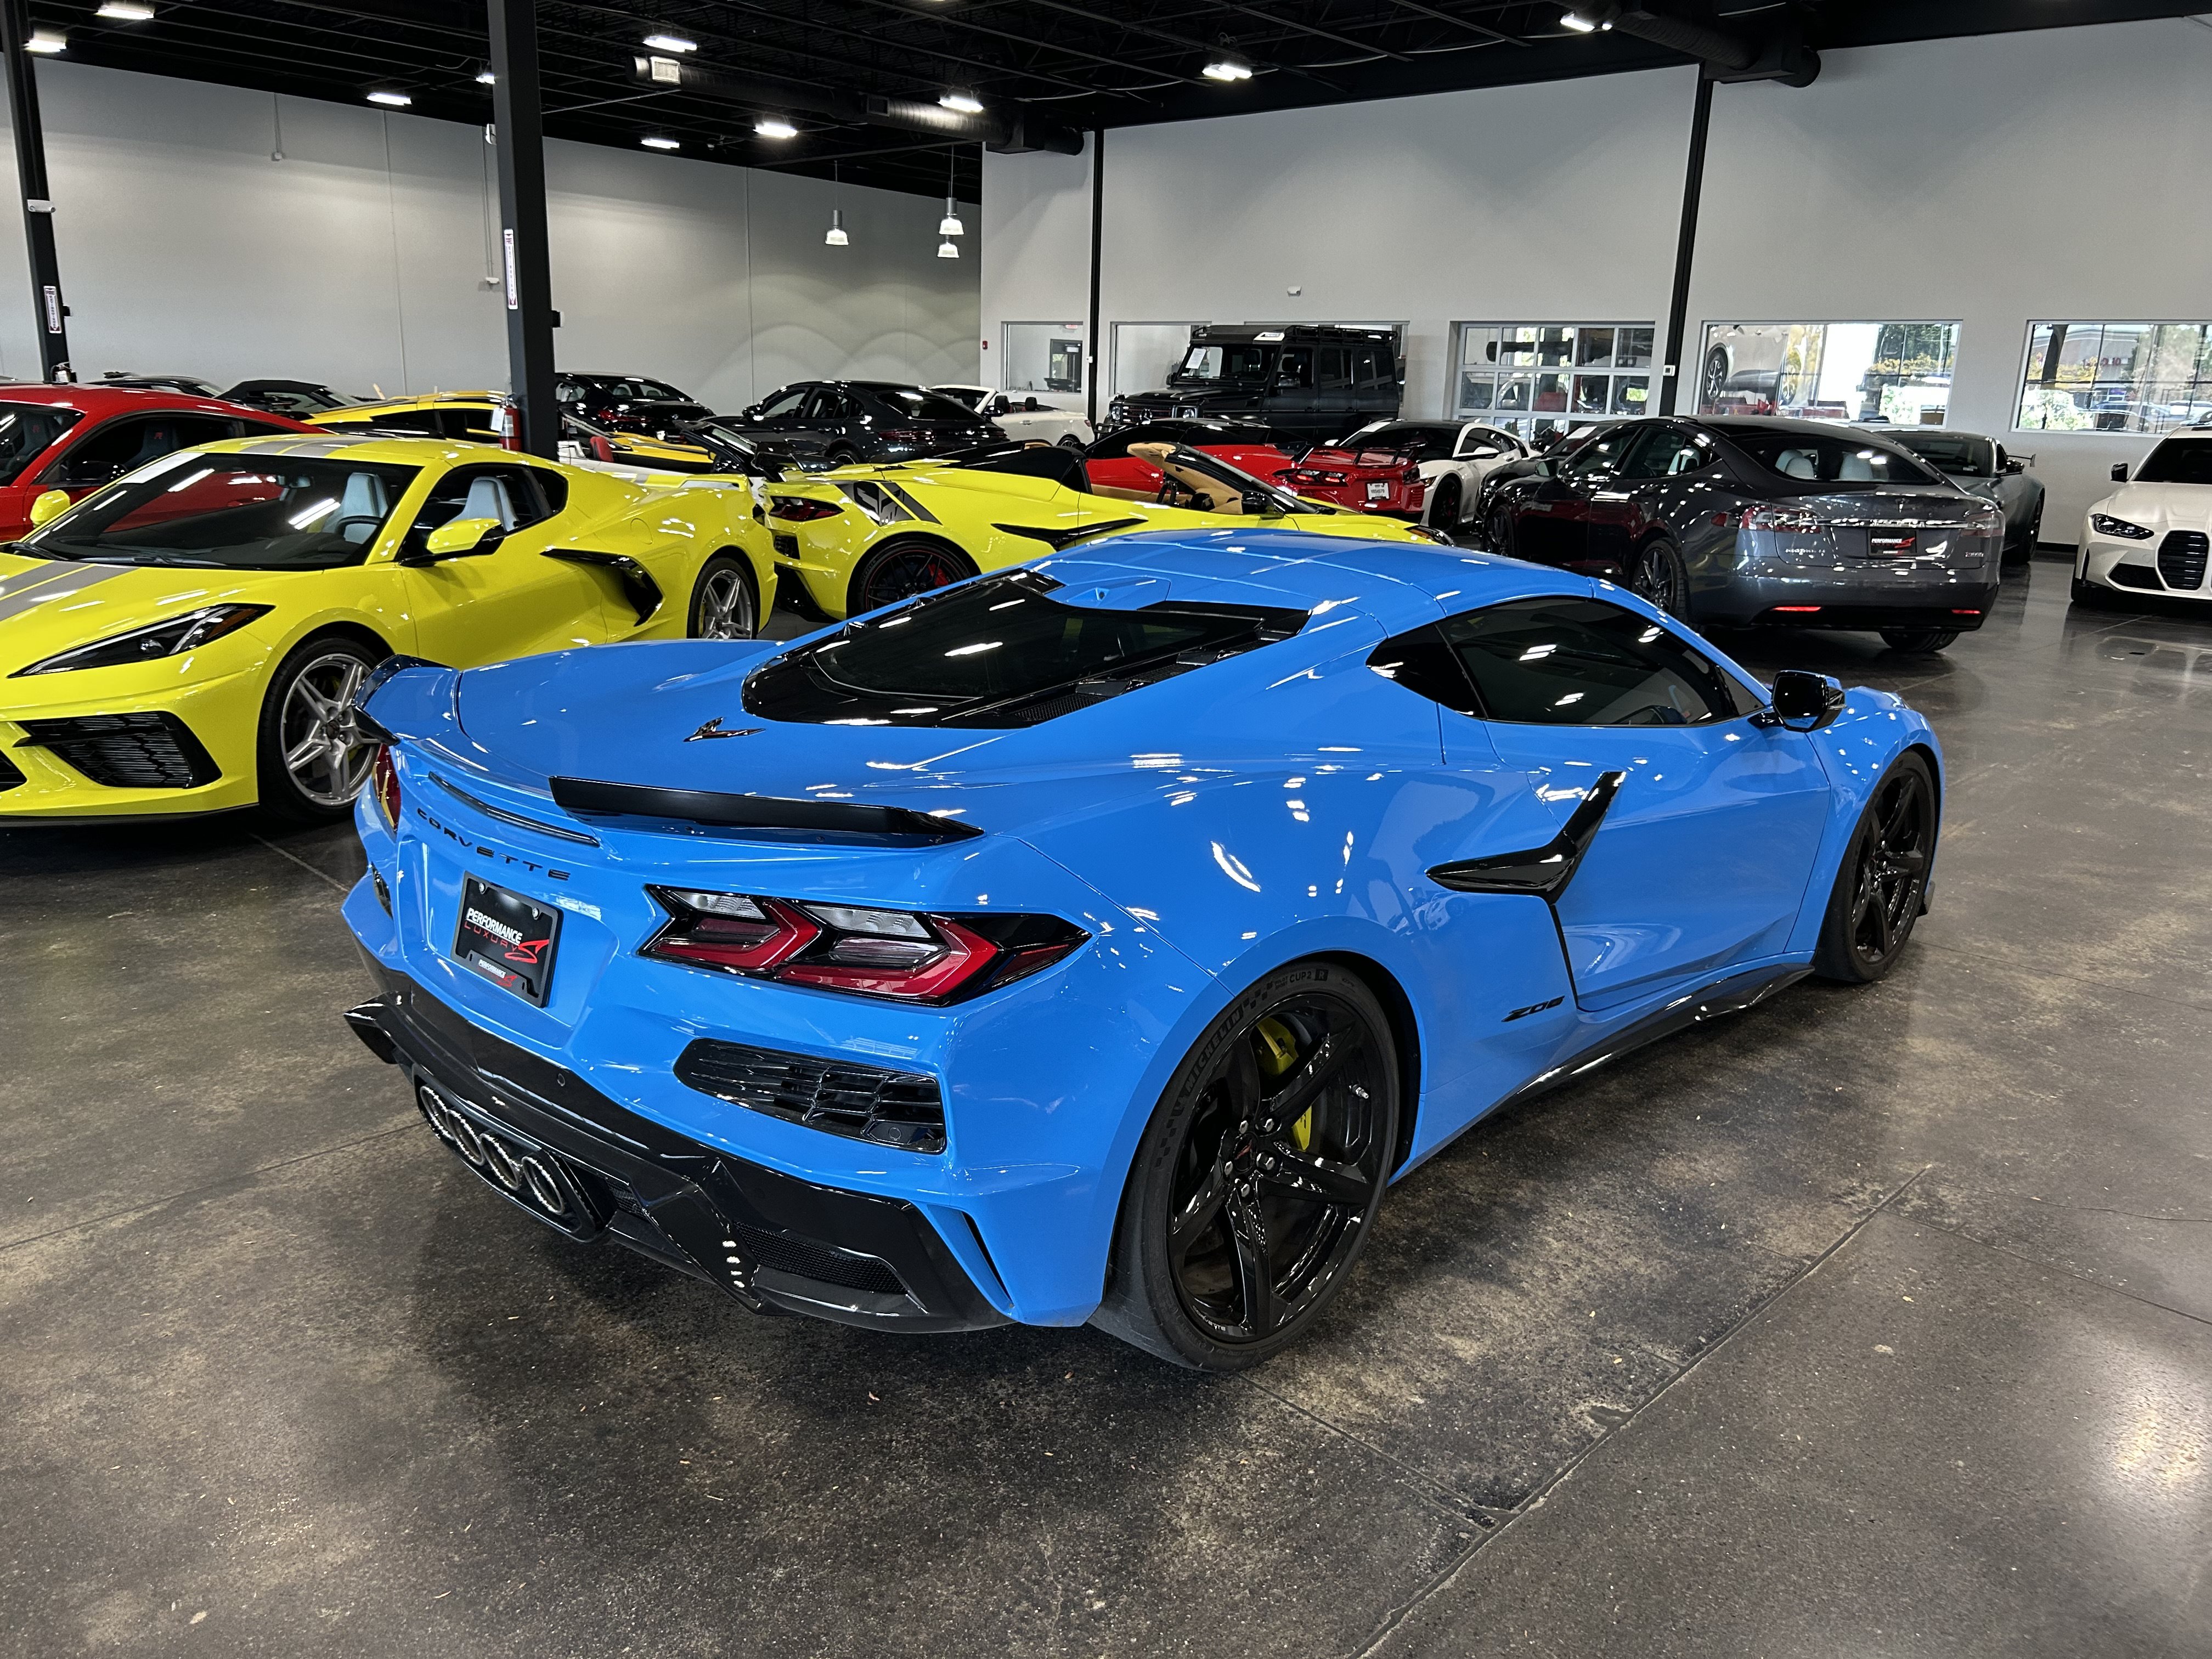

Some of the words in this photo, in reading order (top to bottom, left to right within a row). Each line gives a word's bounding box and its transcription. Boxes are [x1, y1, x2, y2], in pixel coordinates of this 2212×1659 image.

[417, 808, 571, 881] CORVETTE
[464, 921, 518, 952] LUXURY
[467, 907, 523, 944] PERFORMANCE
[1501, 995, 1565, 1022] Z06
[1186, 1009, 1242, 1091] MICHELIN
